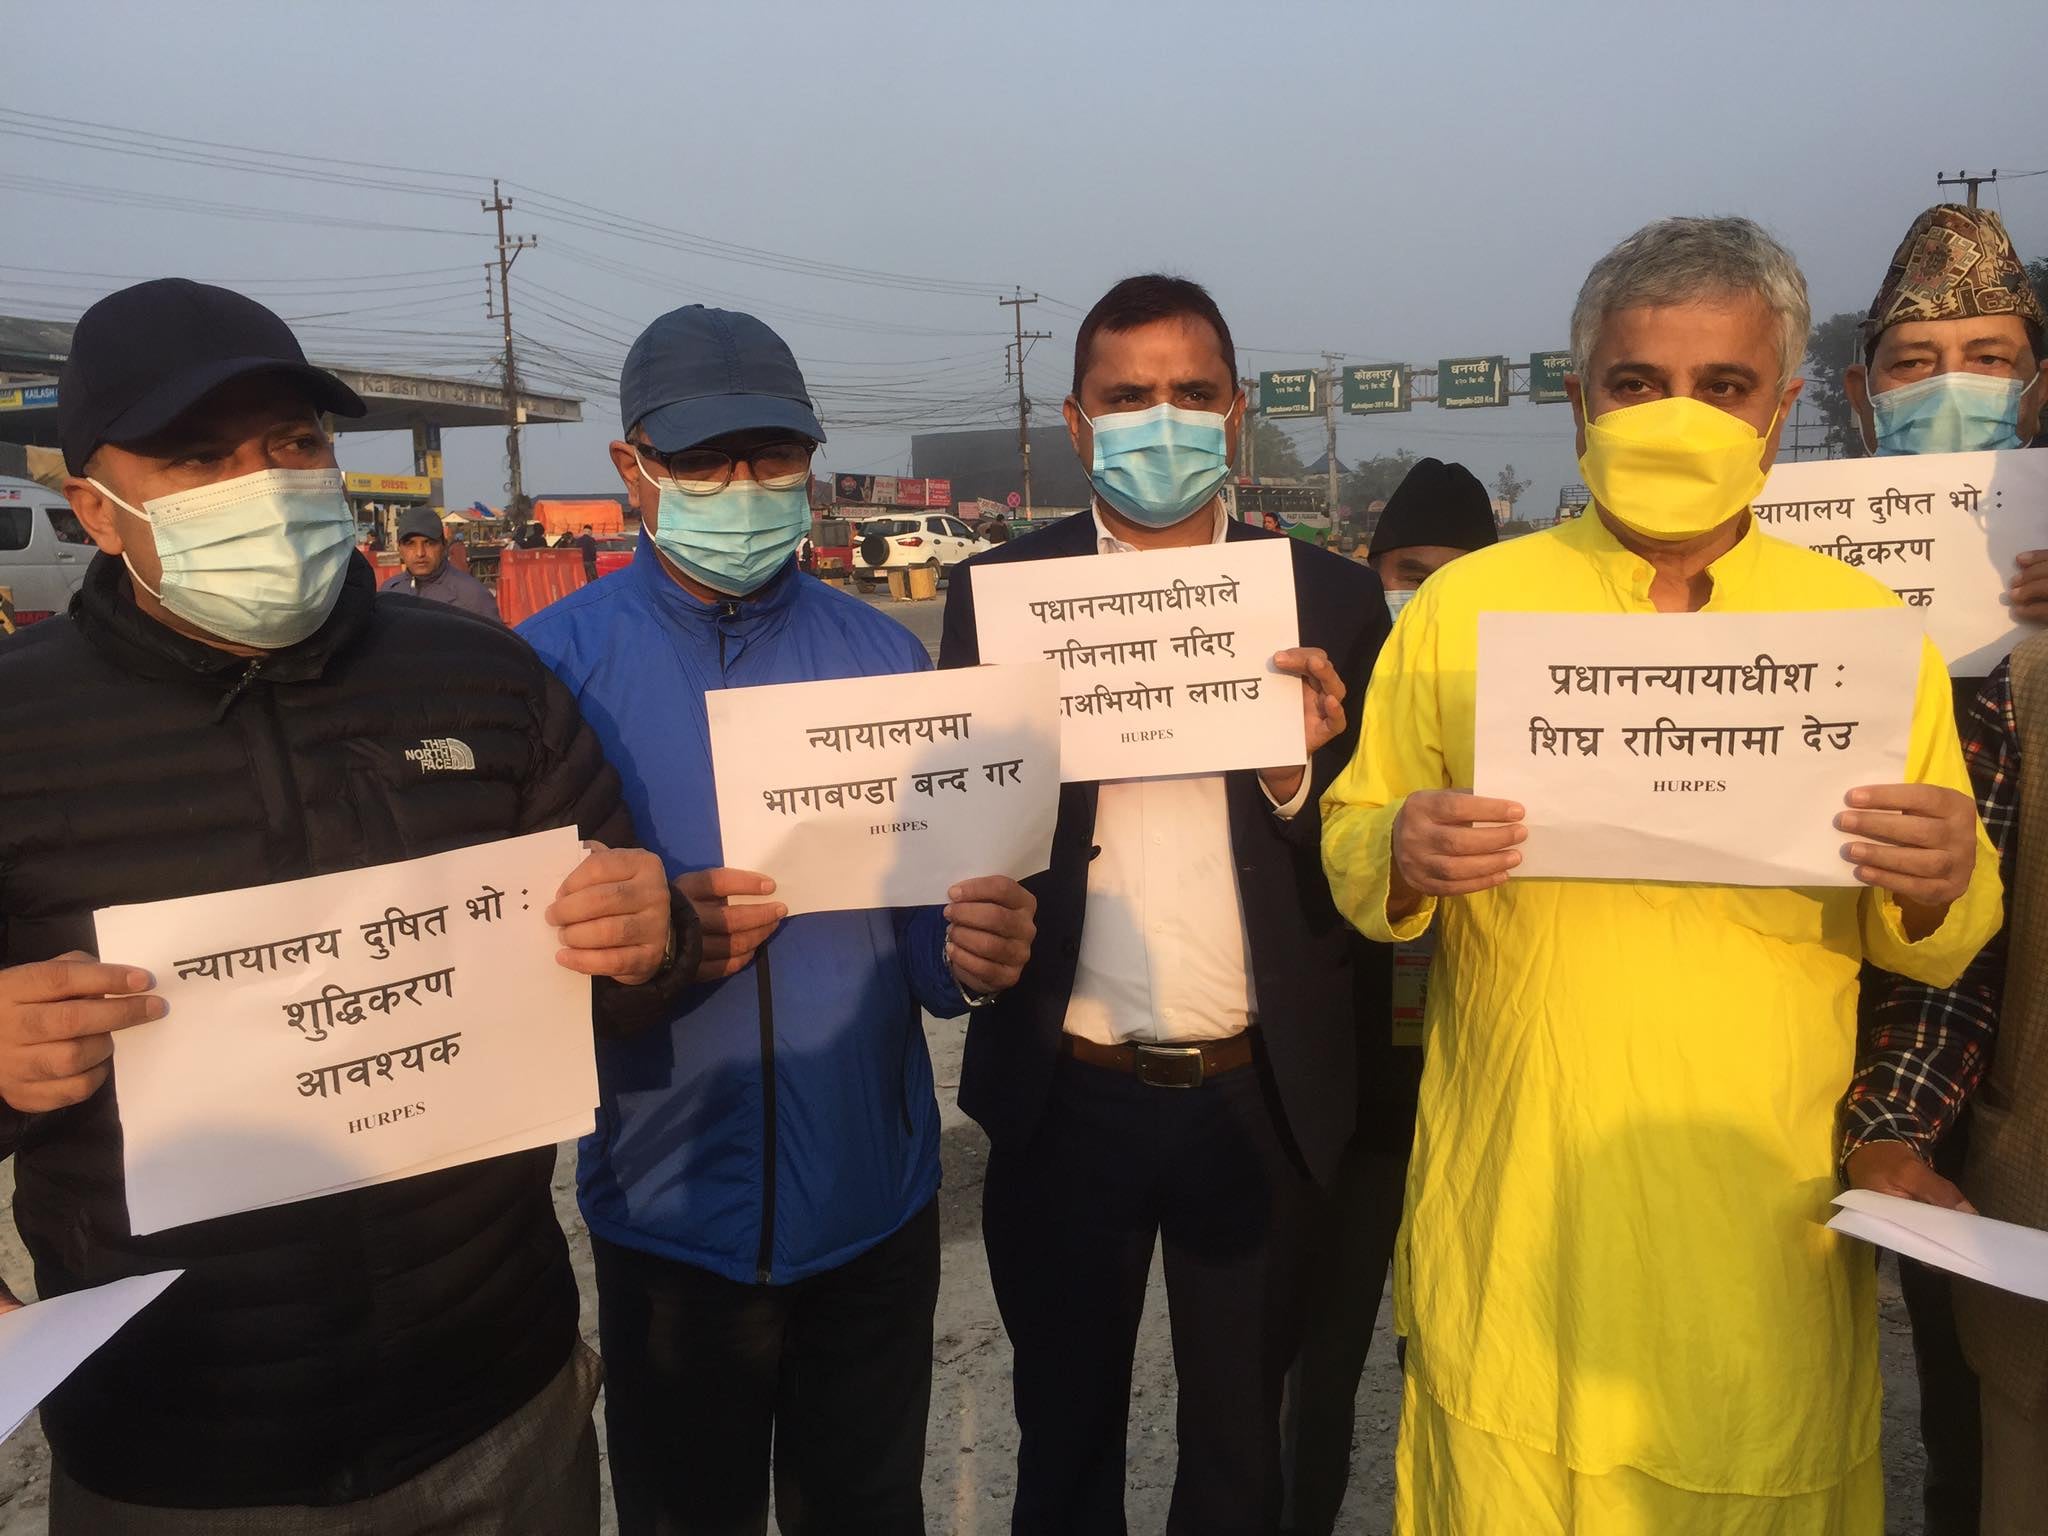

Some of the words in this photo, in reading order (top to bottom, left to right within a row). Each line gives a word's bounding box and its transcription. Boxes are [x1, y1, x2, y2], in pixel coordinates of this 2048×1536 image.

[381, 479, 408, 490] DIESEL
[1868, 487, 1935, 524] दुषित
[1949, 483, 1982, 512] भो
[1170, 626, 1235, 658] नदिए
[1186, 677, 1262, 704] लगाउ
[1548, 653, 1819, 697] प्रधानन्यायाधीश
[421, 739, 448, 749] THE
[806, 712, 972, 753] न्यायालयमा
[1121, 729, 1174, 744] HURPES
[1529, 716, 1604, 757] शिघ्र
[1622, 717, 1784, 757] राजिनामा
[1801, 714, 1859, 752] देउ
[405, 748, 449, 760] NORTH
[421, 759, 452, 773] FACE
[763, 776, 897, 816] भागबण्डा
[911, 768, 969, 798] बन्द
[982, 759, 1023, 788] गर
[1653, 779, 1727, 793] HURPES
[869, 819, 929, 836] HURPES
[173, 929, 343, 982] न्यायालय
[360, 905, 449, 960] दुषित
[465, 885, 506, 922] भो
[282, 966, 456, 1042] शुद्धिकरण
[296, 1031, 462, 1099] आवश्यक
[348, 1101, 426, 1134] HURPES
